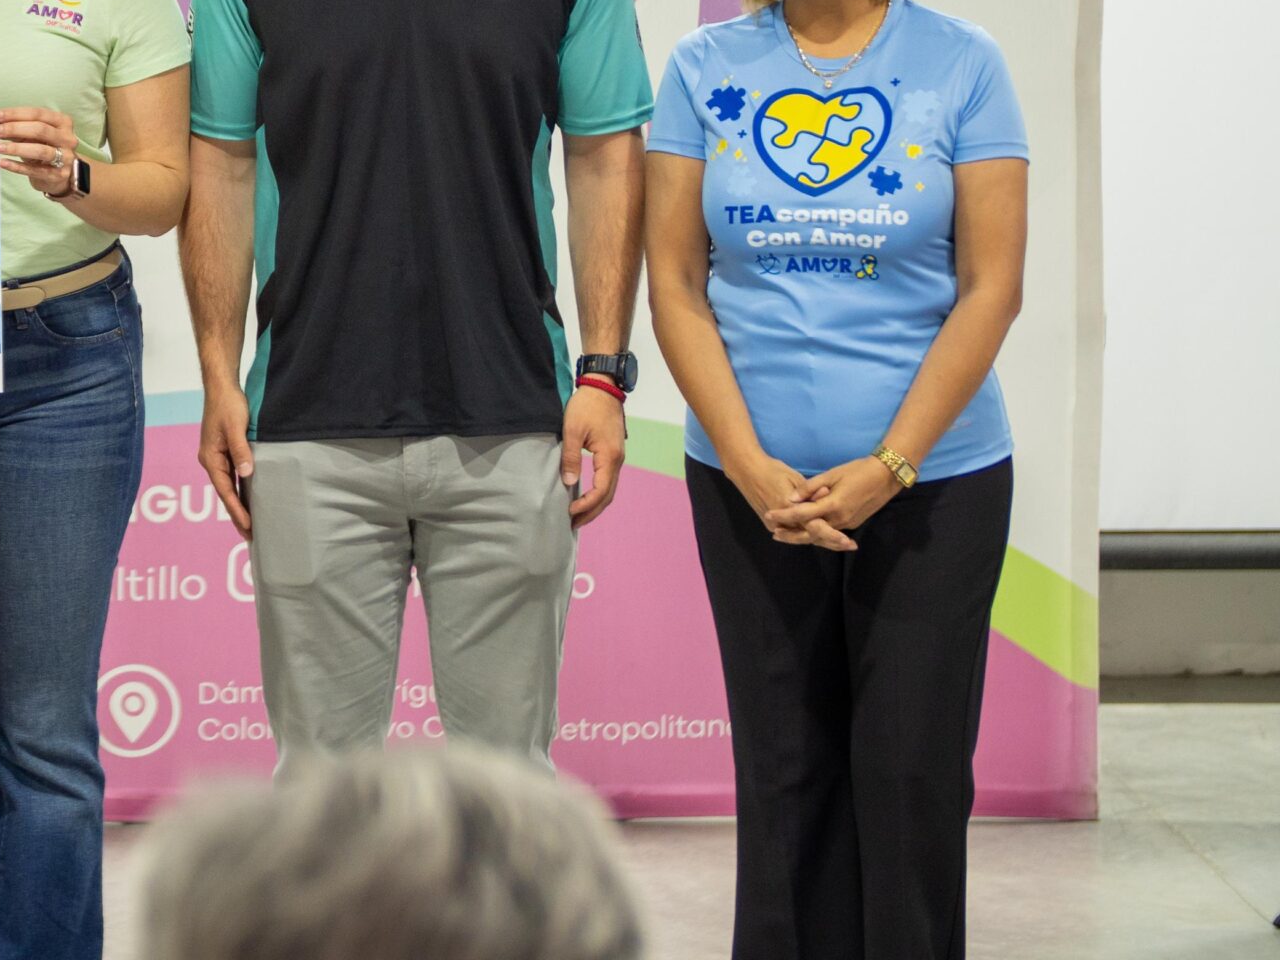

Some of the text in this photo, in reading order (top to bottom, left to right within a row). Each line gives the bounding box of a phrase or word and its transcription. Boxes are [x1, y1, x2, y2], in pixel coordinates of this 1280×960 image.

[725, 203, 910, 228] TEAcompaño
[746, 227, 887, 249] Con Amor
